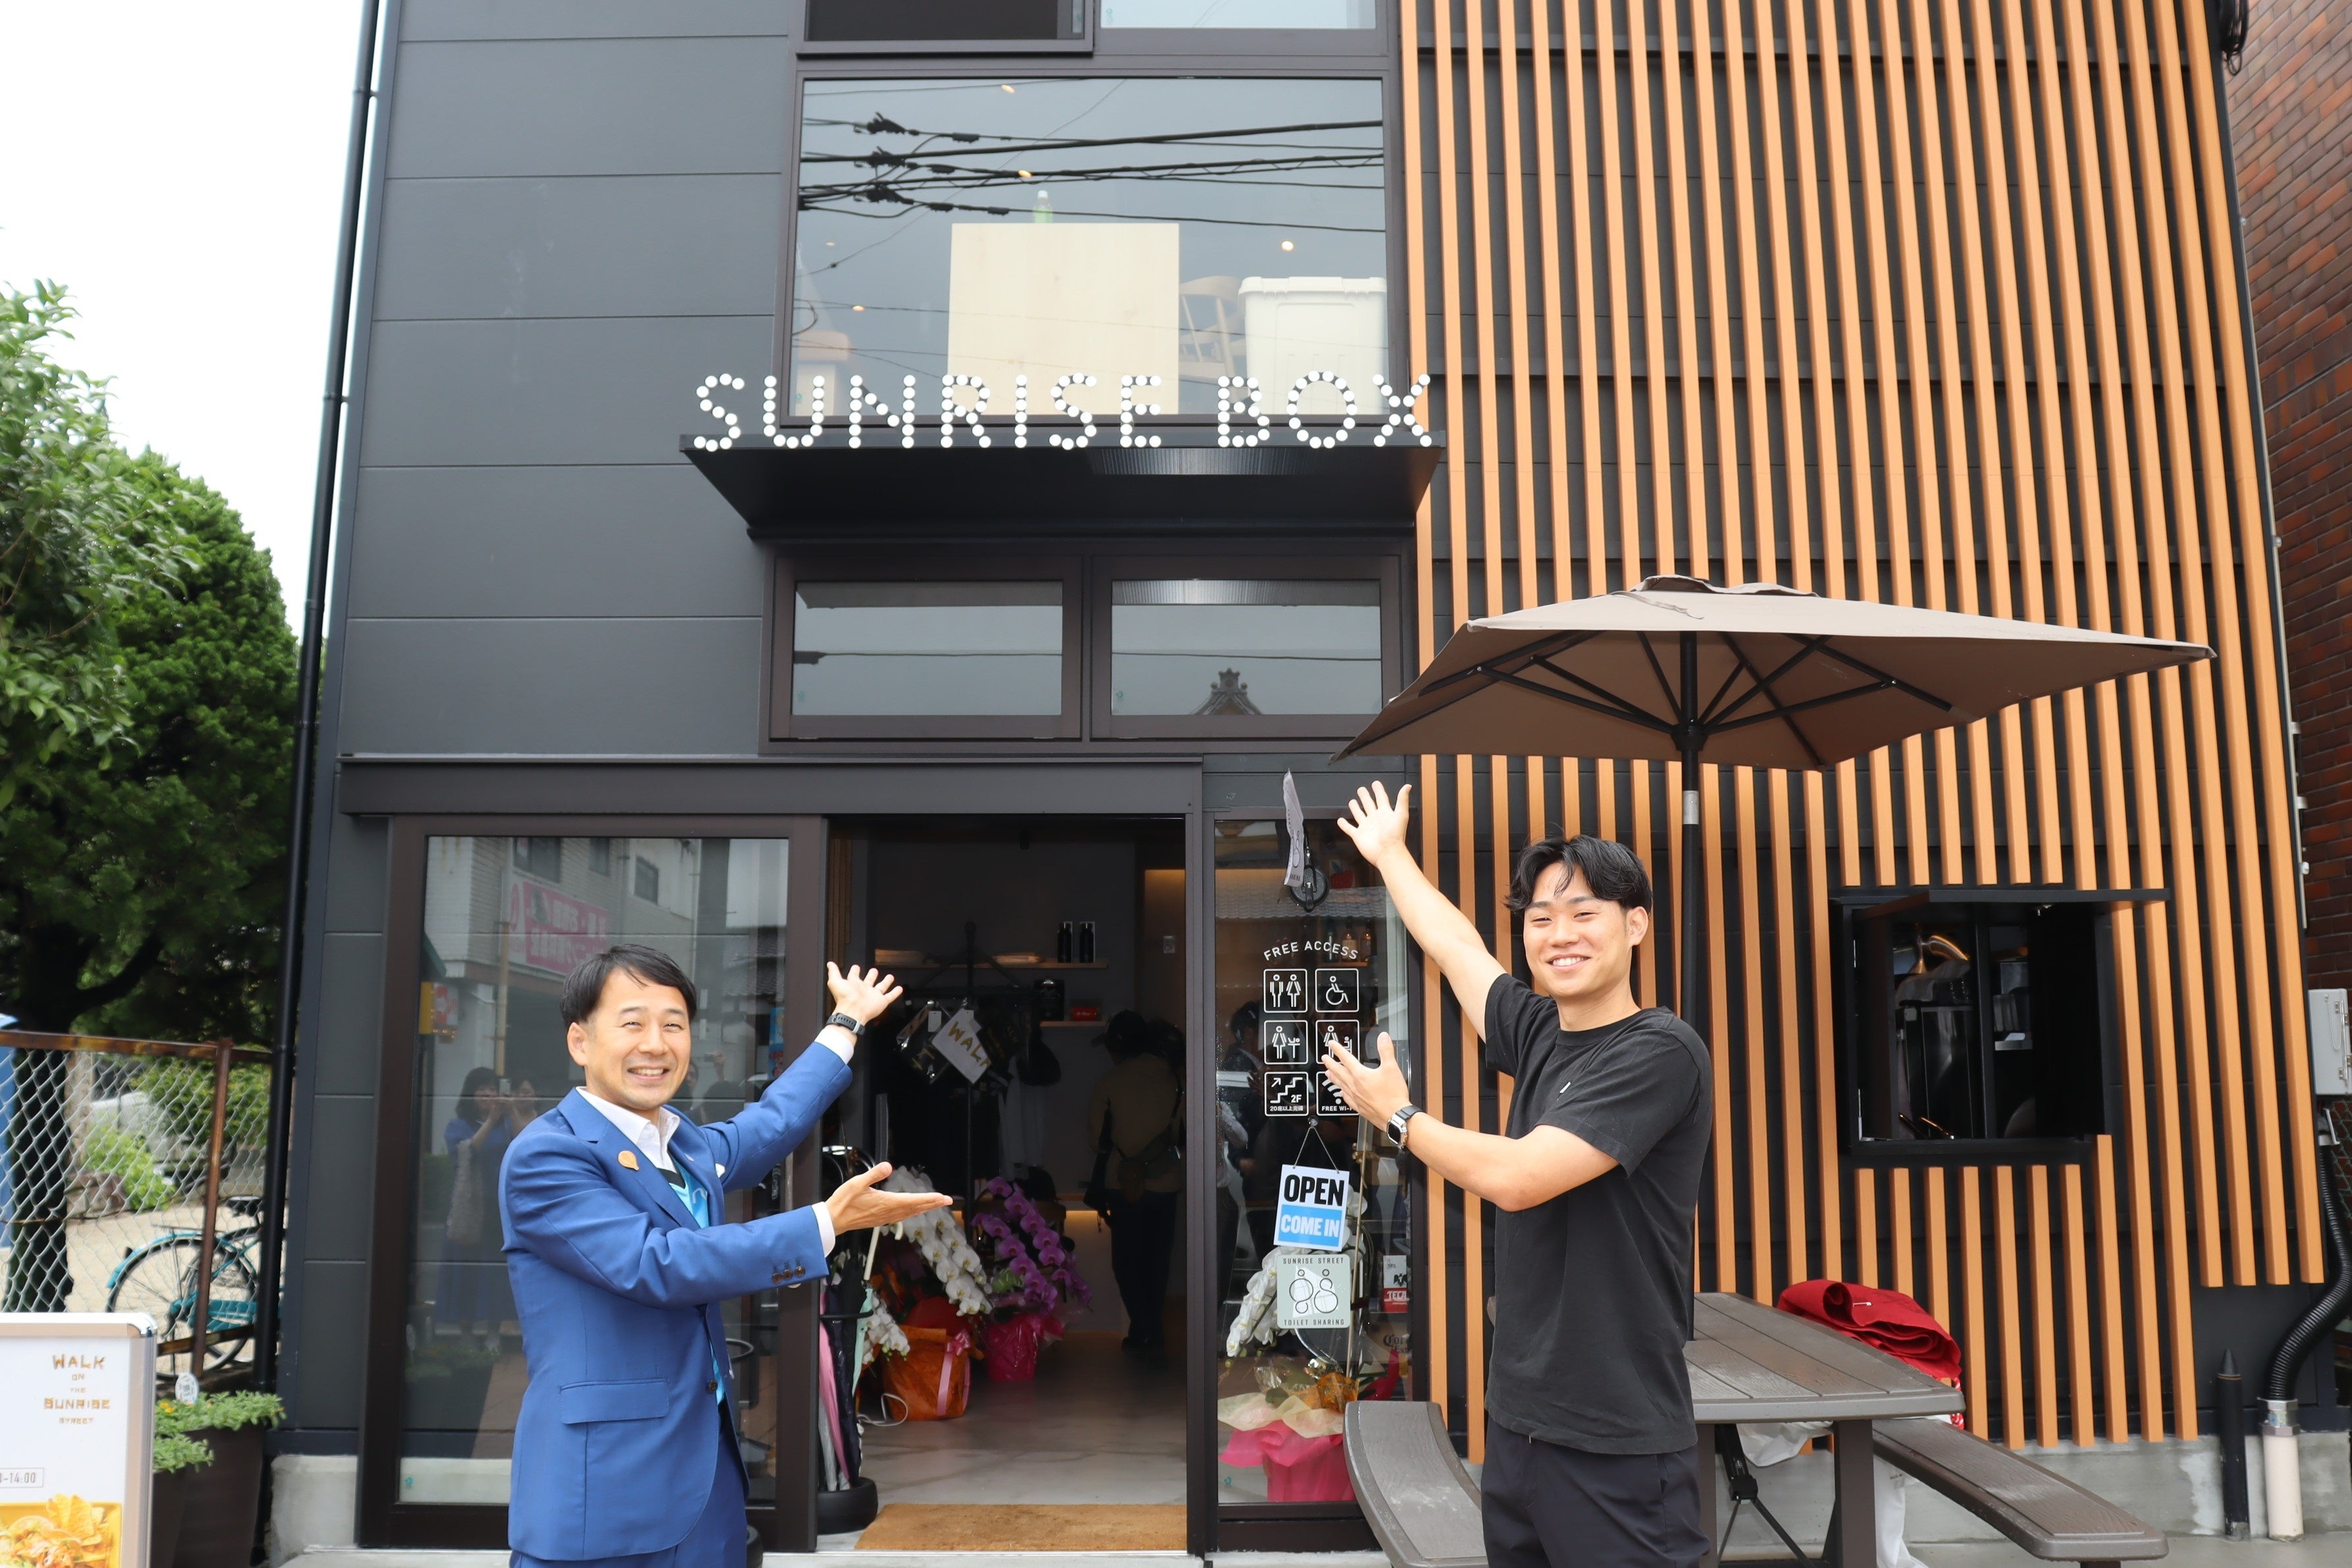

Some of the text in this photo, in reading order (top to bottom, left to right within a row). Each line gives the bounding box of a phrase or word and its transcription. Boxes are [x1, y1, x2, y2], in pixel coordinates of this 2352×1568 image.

[694, 371, 1432, 452] SUNRISE BOX
[1263, 940, 1358, 961] FREE ACCESS
[1291, 1094, 1302, 1104] 2F
[1283, 1174, 1345, 1207] OPEN
[1280, 1214, 1340, 1238] COME IN
[1386, 1290, 1407, 1300] TECA
[52, 1353, 105, 1370] WALK
[43, 1397, 111, 1410] SUNRISE
